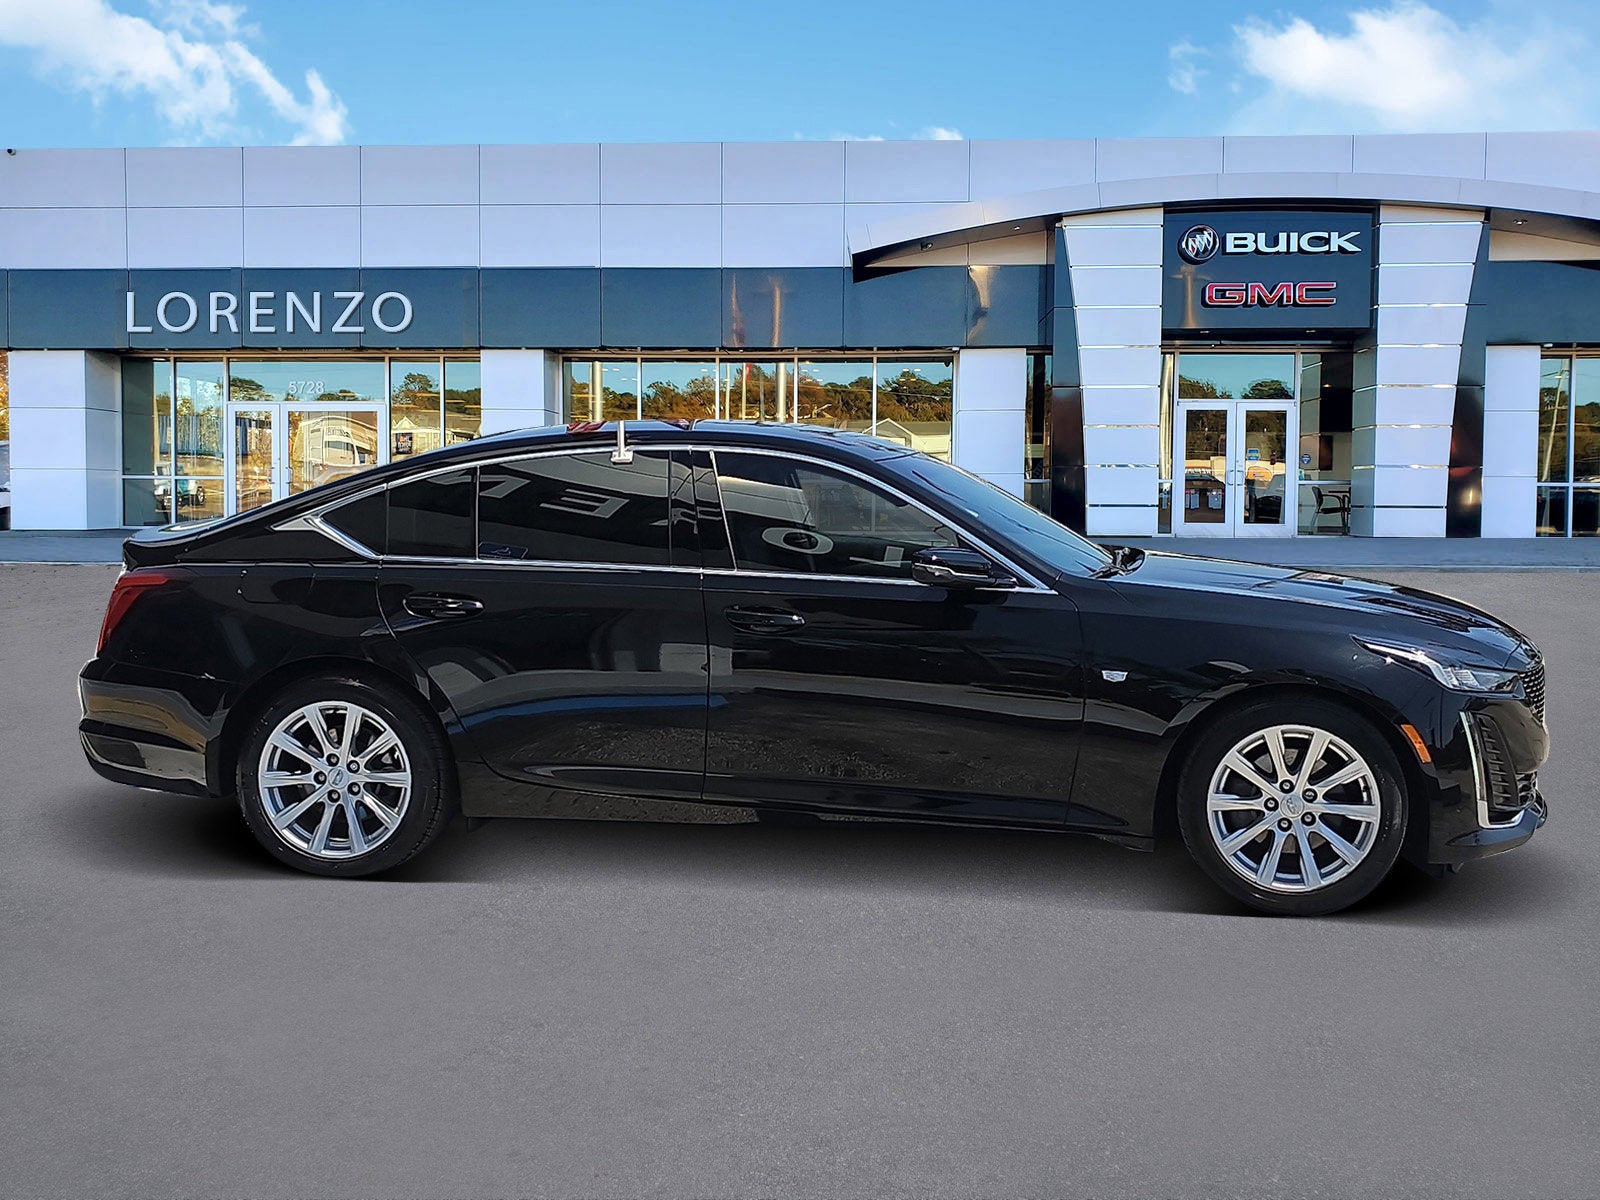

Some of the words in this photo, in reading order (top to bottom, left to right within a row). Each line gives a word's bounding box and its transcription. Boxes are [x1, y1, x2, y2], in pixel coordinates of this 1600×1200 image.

[1226, 231, 1362, 253] BUICK
[1205, 281, 1337, 306] GMC
[126, 291, 413, 333] LORENZO
[288, 381, 325, 394] 5728
